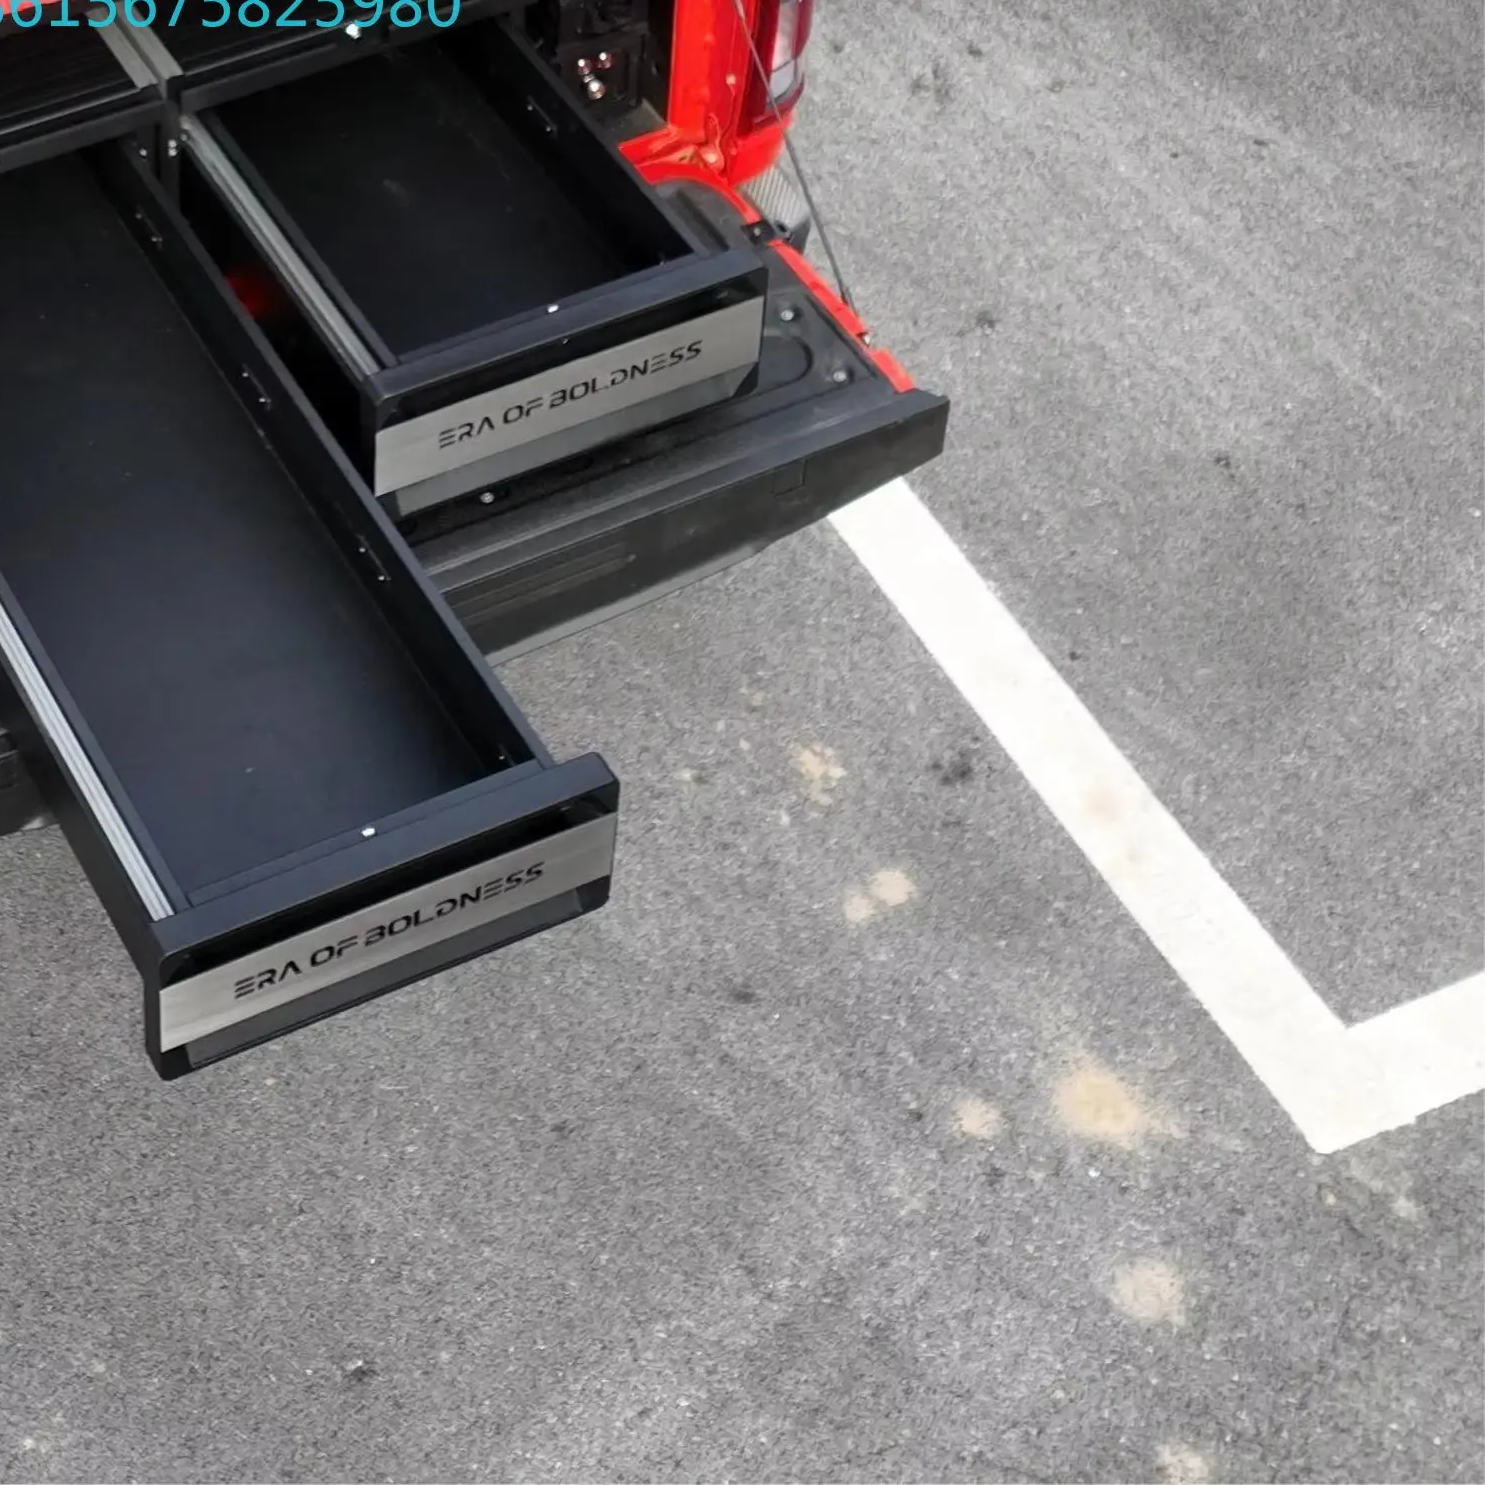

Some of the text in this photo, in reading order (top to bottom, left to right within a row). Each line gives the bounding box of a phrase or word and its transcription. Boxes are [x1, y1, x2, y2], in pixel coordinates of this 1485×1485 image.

[438, 339, 704, 450] ERA OF BOLDNESS
[234, 860, 546, 1000] ERA OF BOLDNESS
